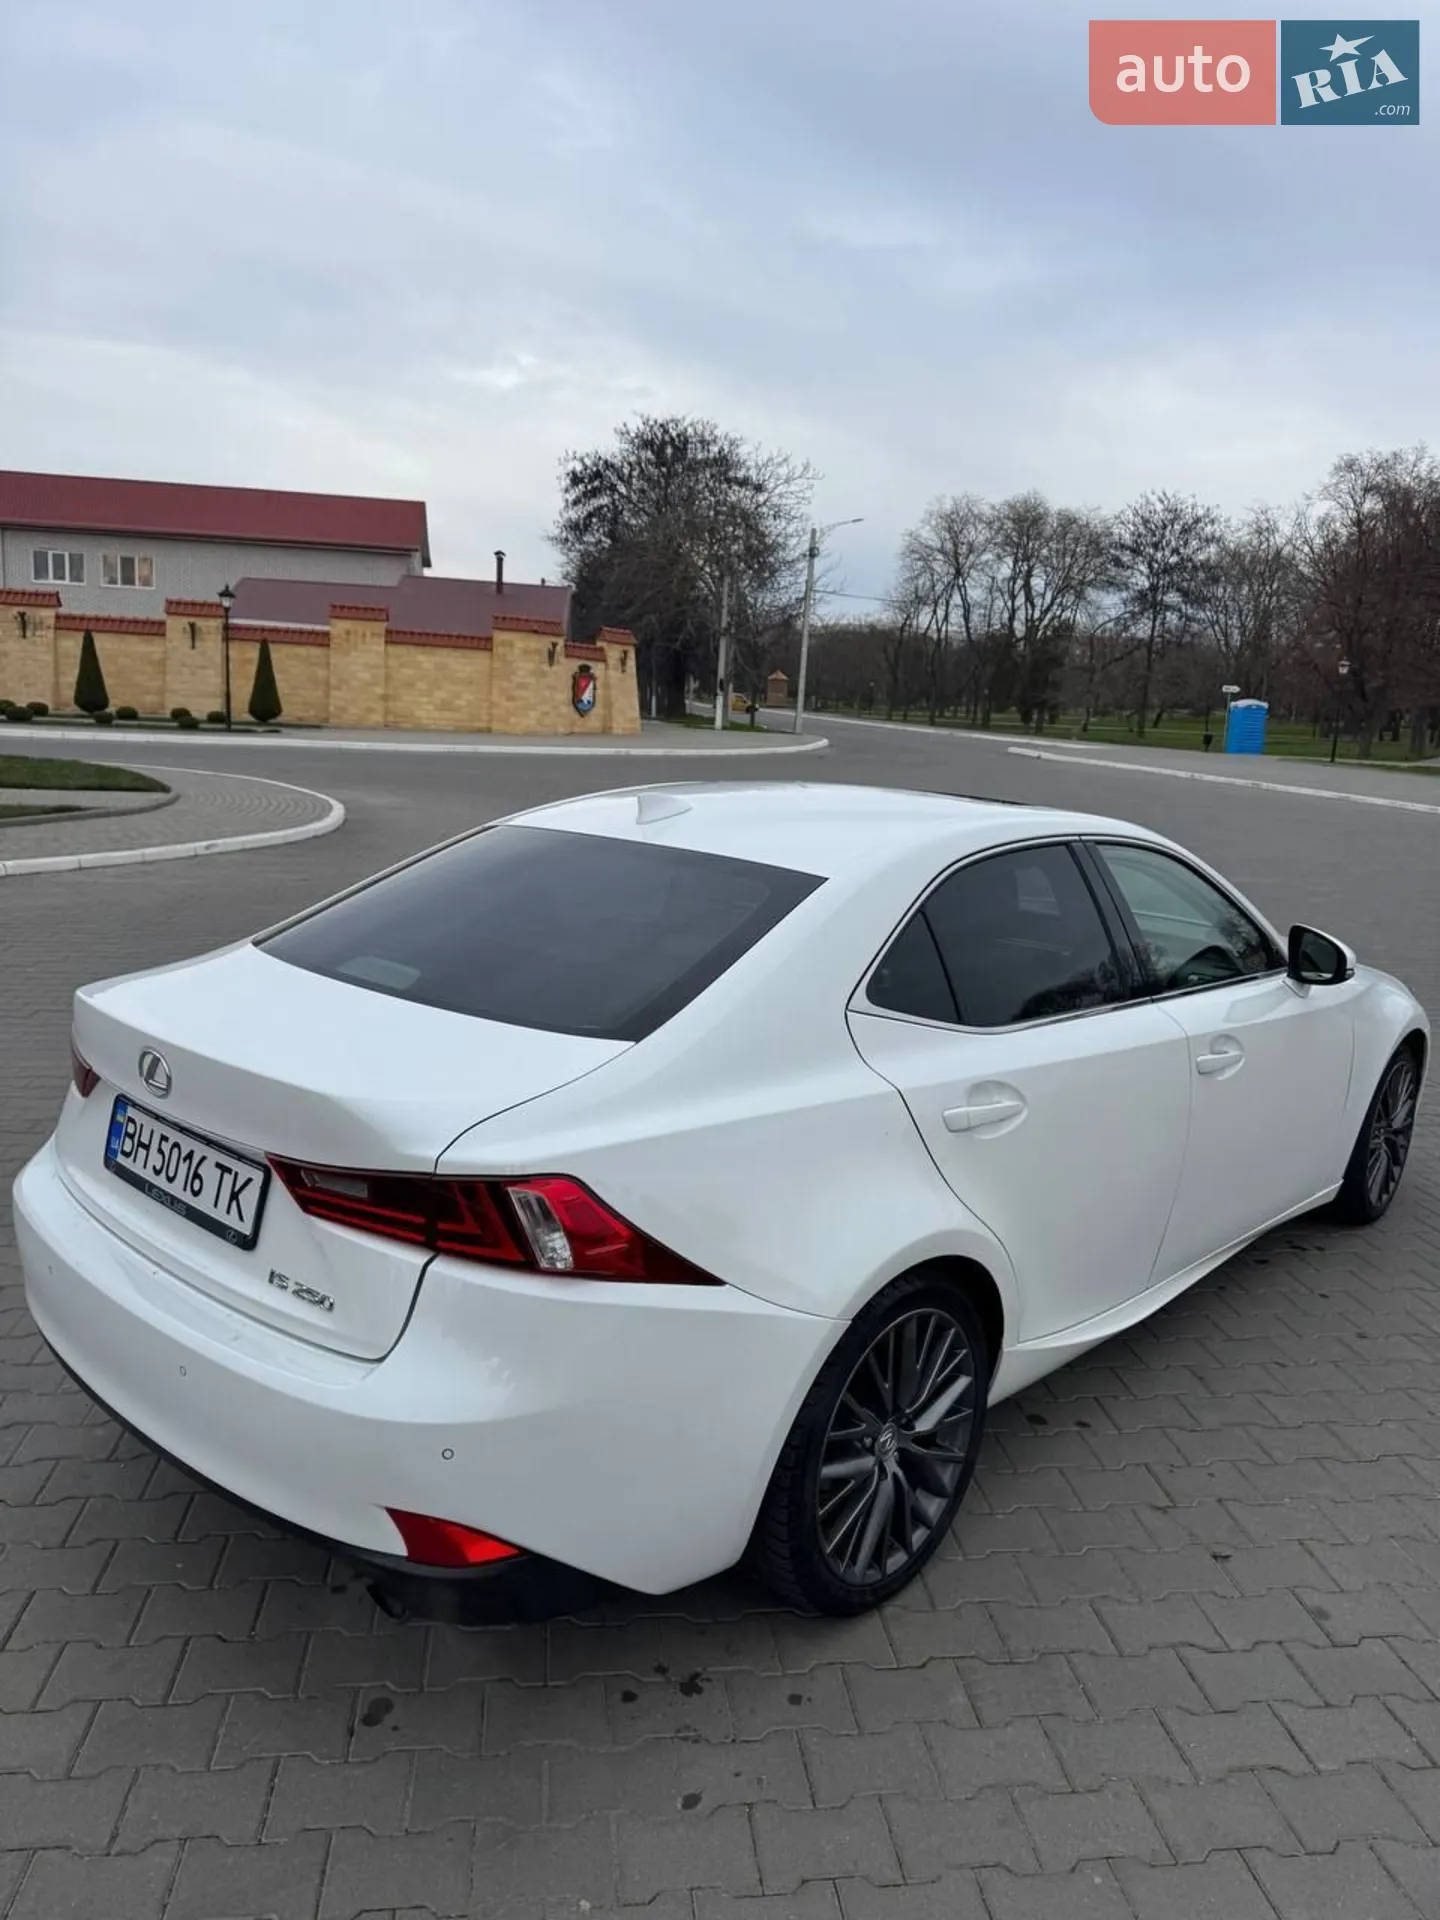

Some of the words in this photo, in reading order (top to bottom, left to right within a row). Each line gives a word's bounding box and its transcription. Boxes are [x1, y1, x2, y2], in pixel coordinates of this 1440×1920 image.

[120, 1115, 154, 1170] BH
[152, 1133, 207, 1198] 5016
[214, 1161, 254, 1223] TK
